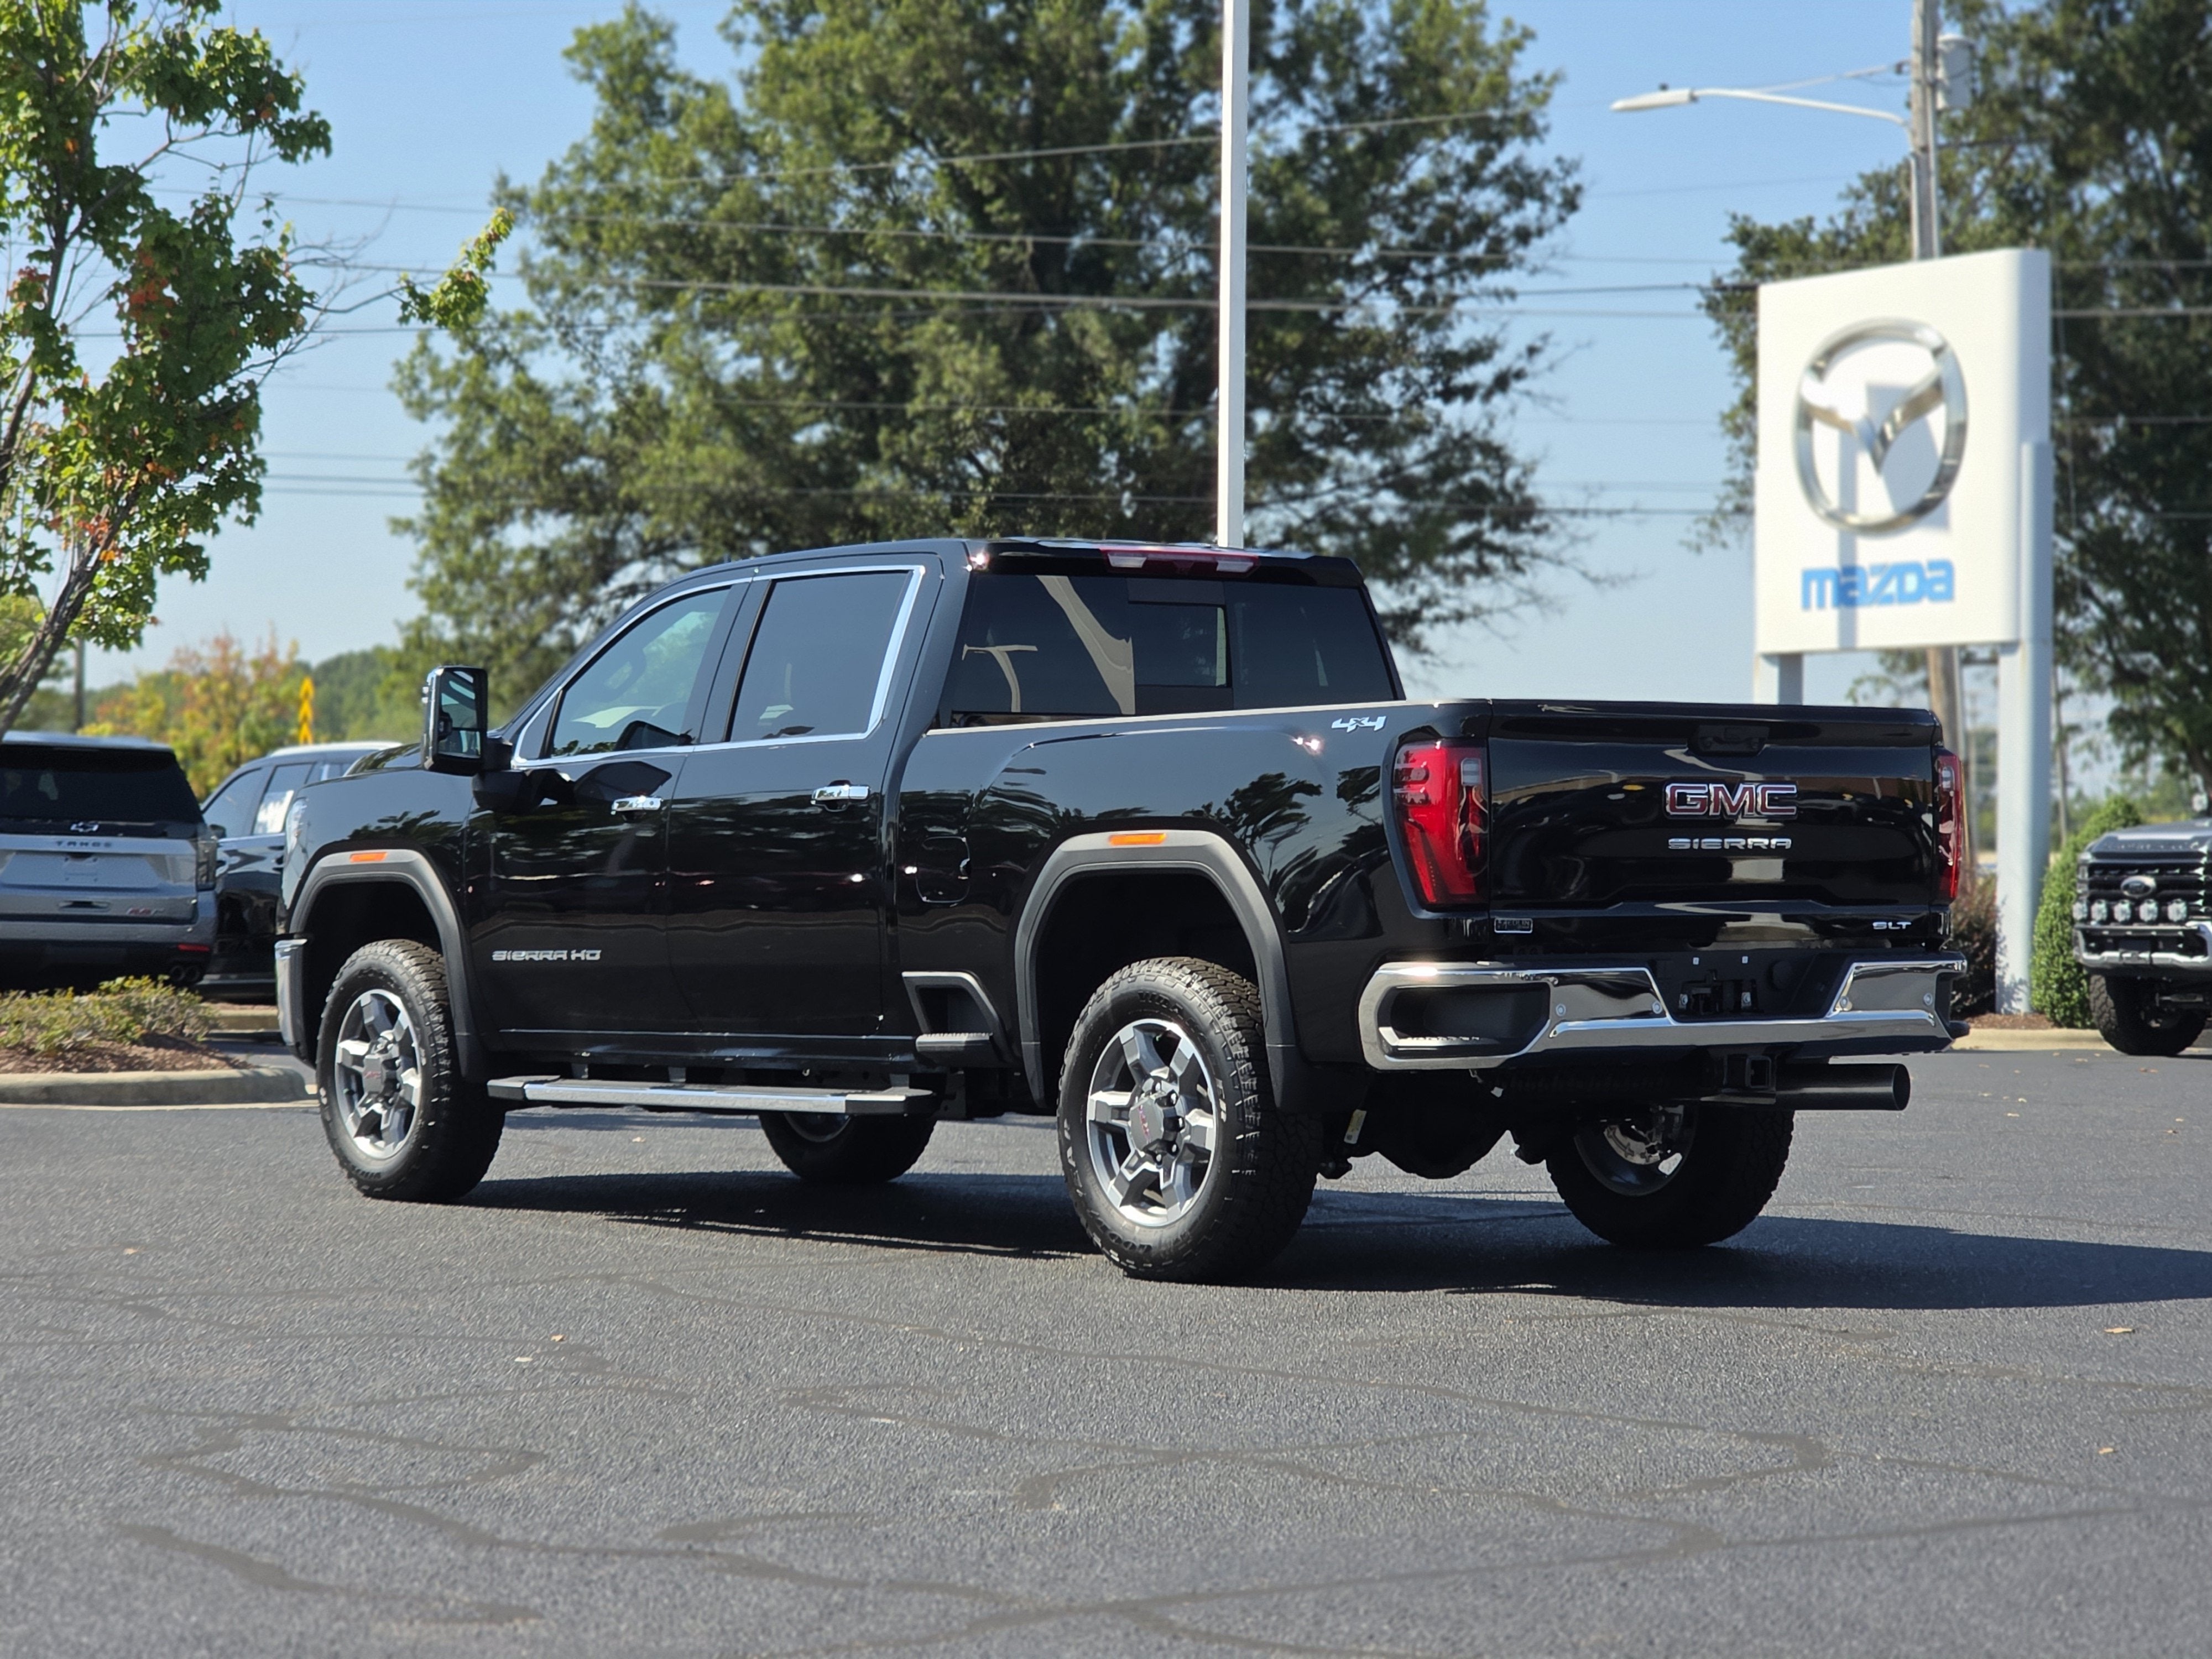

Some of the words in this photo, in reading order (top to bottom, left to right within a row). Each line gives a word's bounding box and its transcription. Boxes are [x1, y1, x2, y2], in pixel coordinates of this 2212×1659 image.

[1666, 783, 1797, 815] GMC
[1668, 838, 1792, 849] SIERRA
[1872, 921, 1912, 930] SLT
[492, 950, 568, 961] SIERRA
[570, 950, 602, 961] HD
